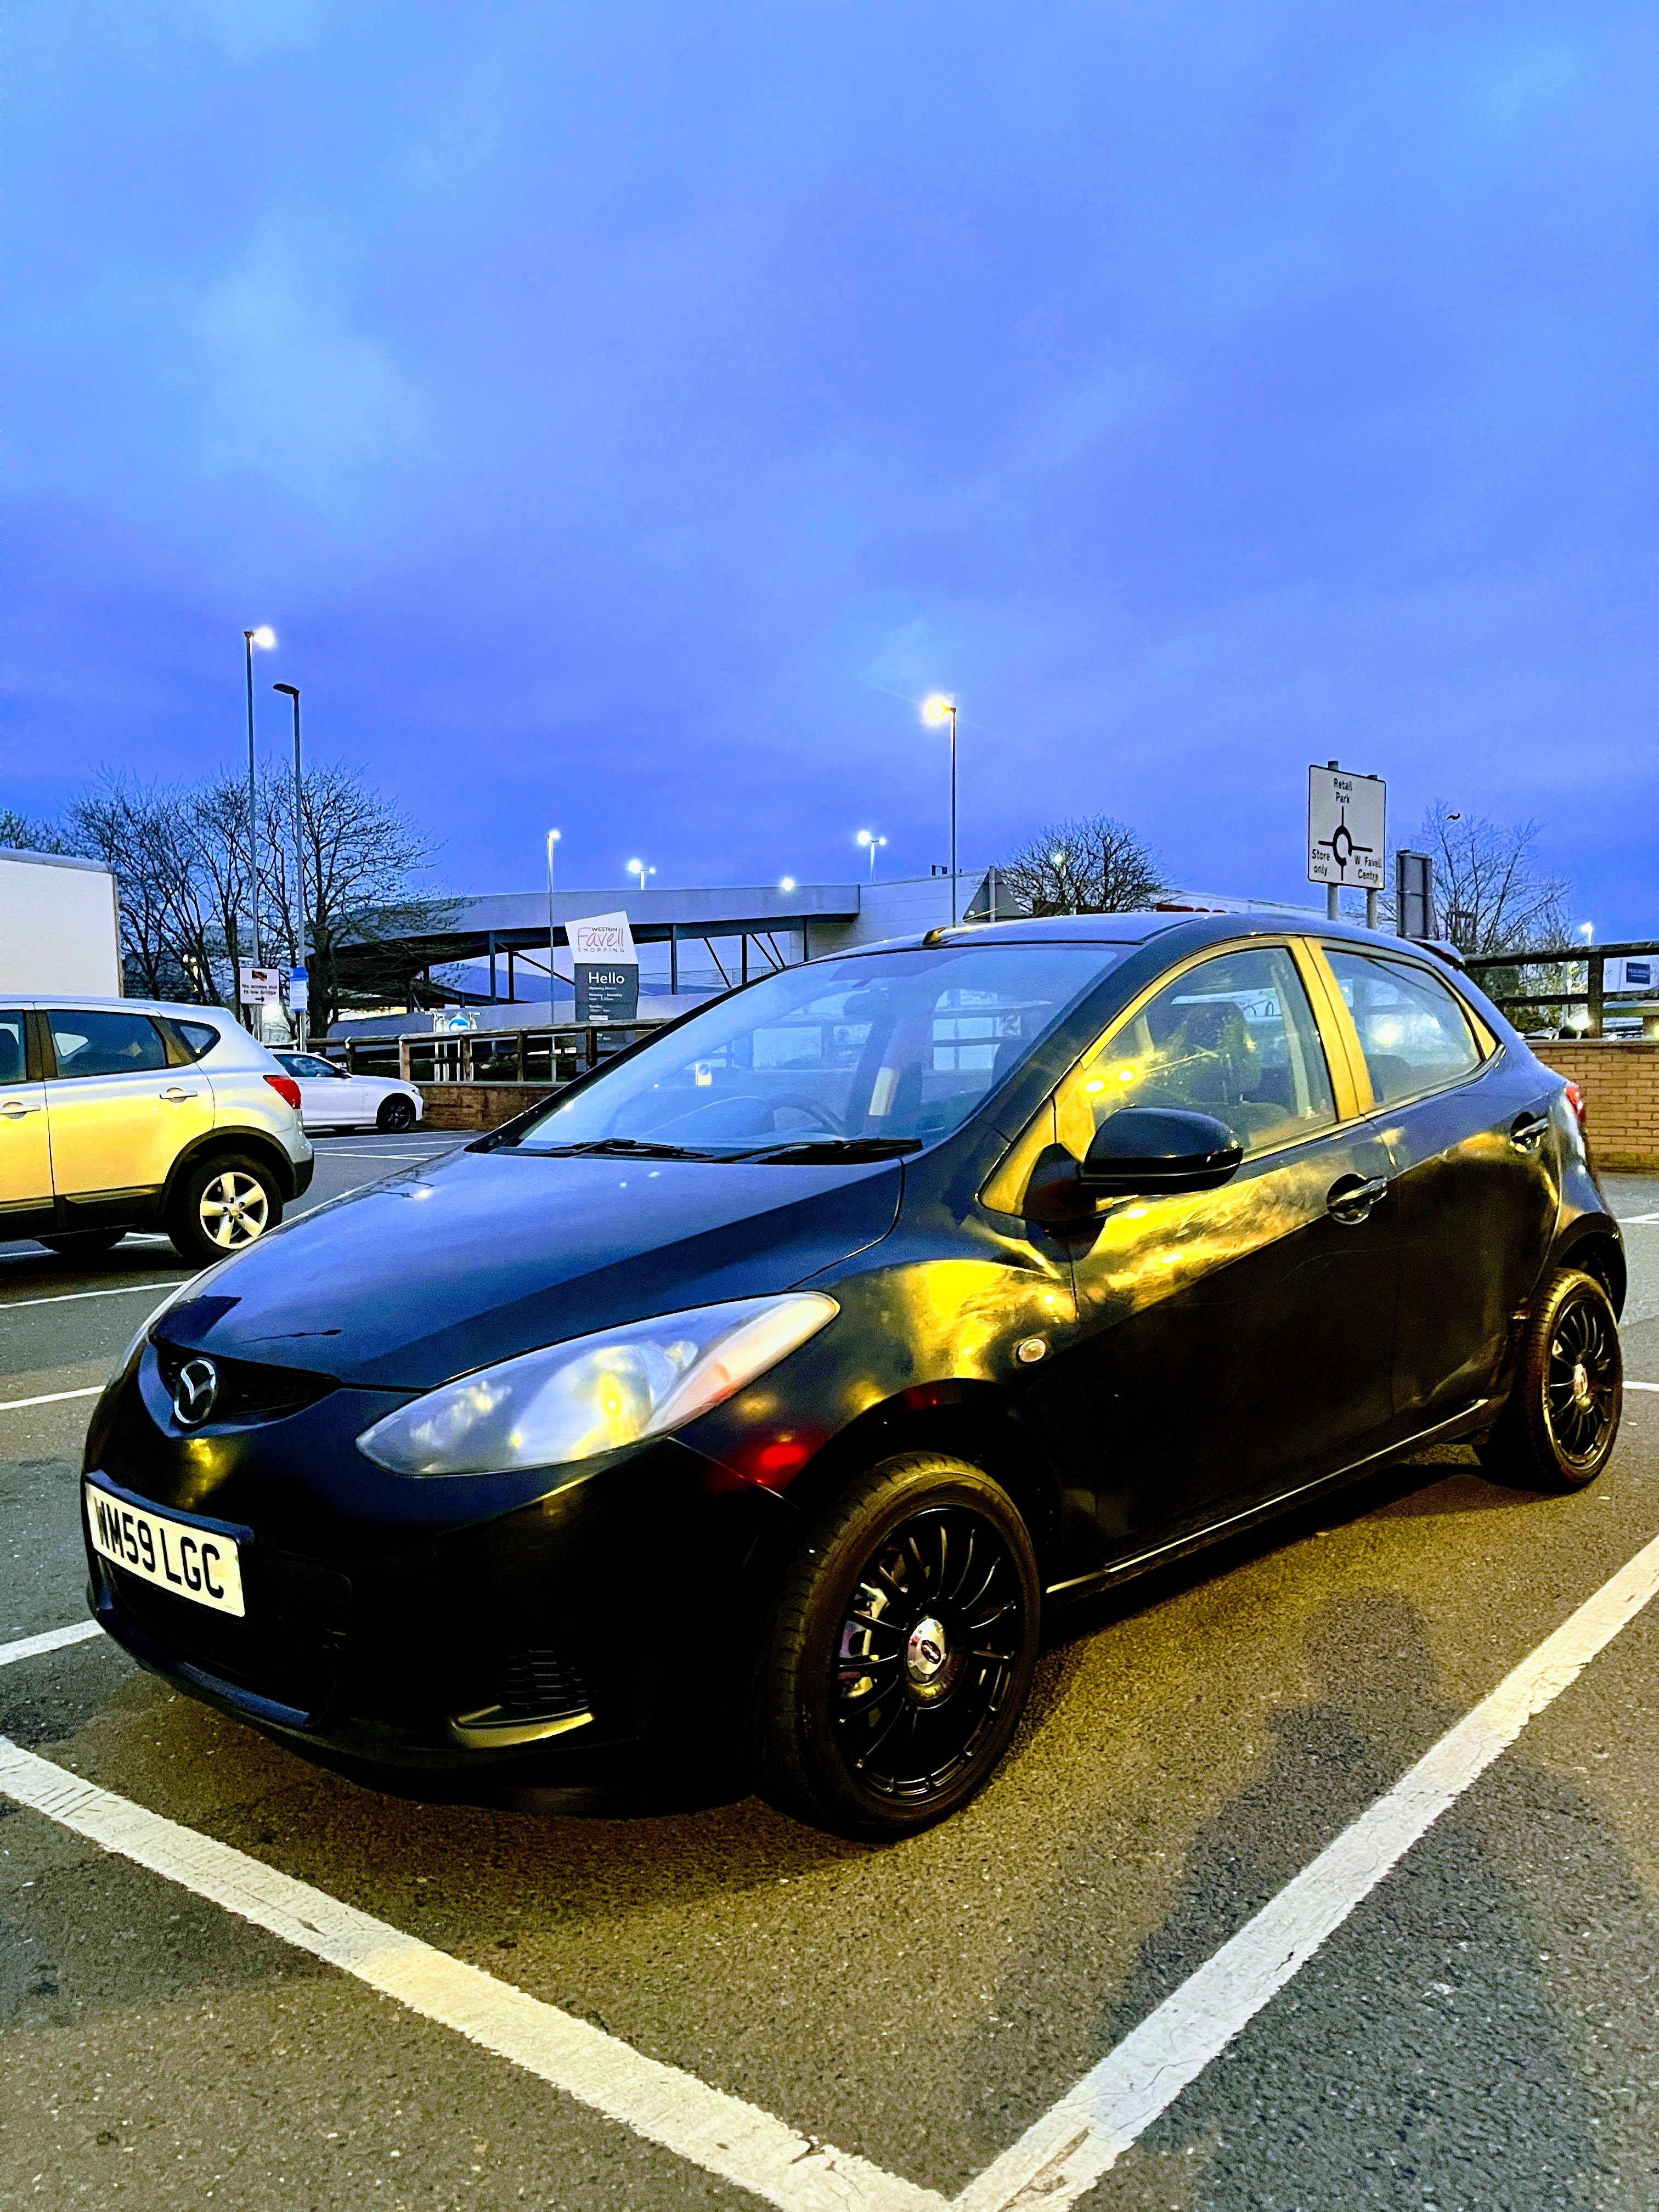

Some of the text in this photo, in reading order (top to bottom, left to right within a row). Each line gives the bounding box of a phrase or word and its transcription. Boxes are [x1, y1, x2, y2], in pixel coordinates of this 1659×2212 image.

[1334, 778, 1352, 791] Retail
[1336, 792, 1350, 803] Park
[1312, 849, 1330, 861] Store
[1364, 856, 1382, 868] Favell
[1314, 864, 1328, 876] only
[1358, 869, 1379, 881] Centre
[578, 927, 624, 947] Favell
[589, 972, 624, 984] Hello
[160, 1528, 224, 1599] LGC
